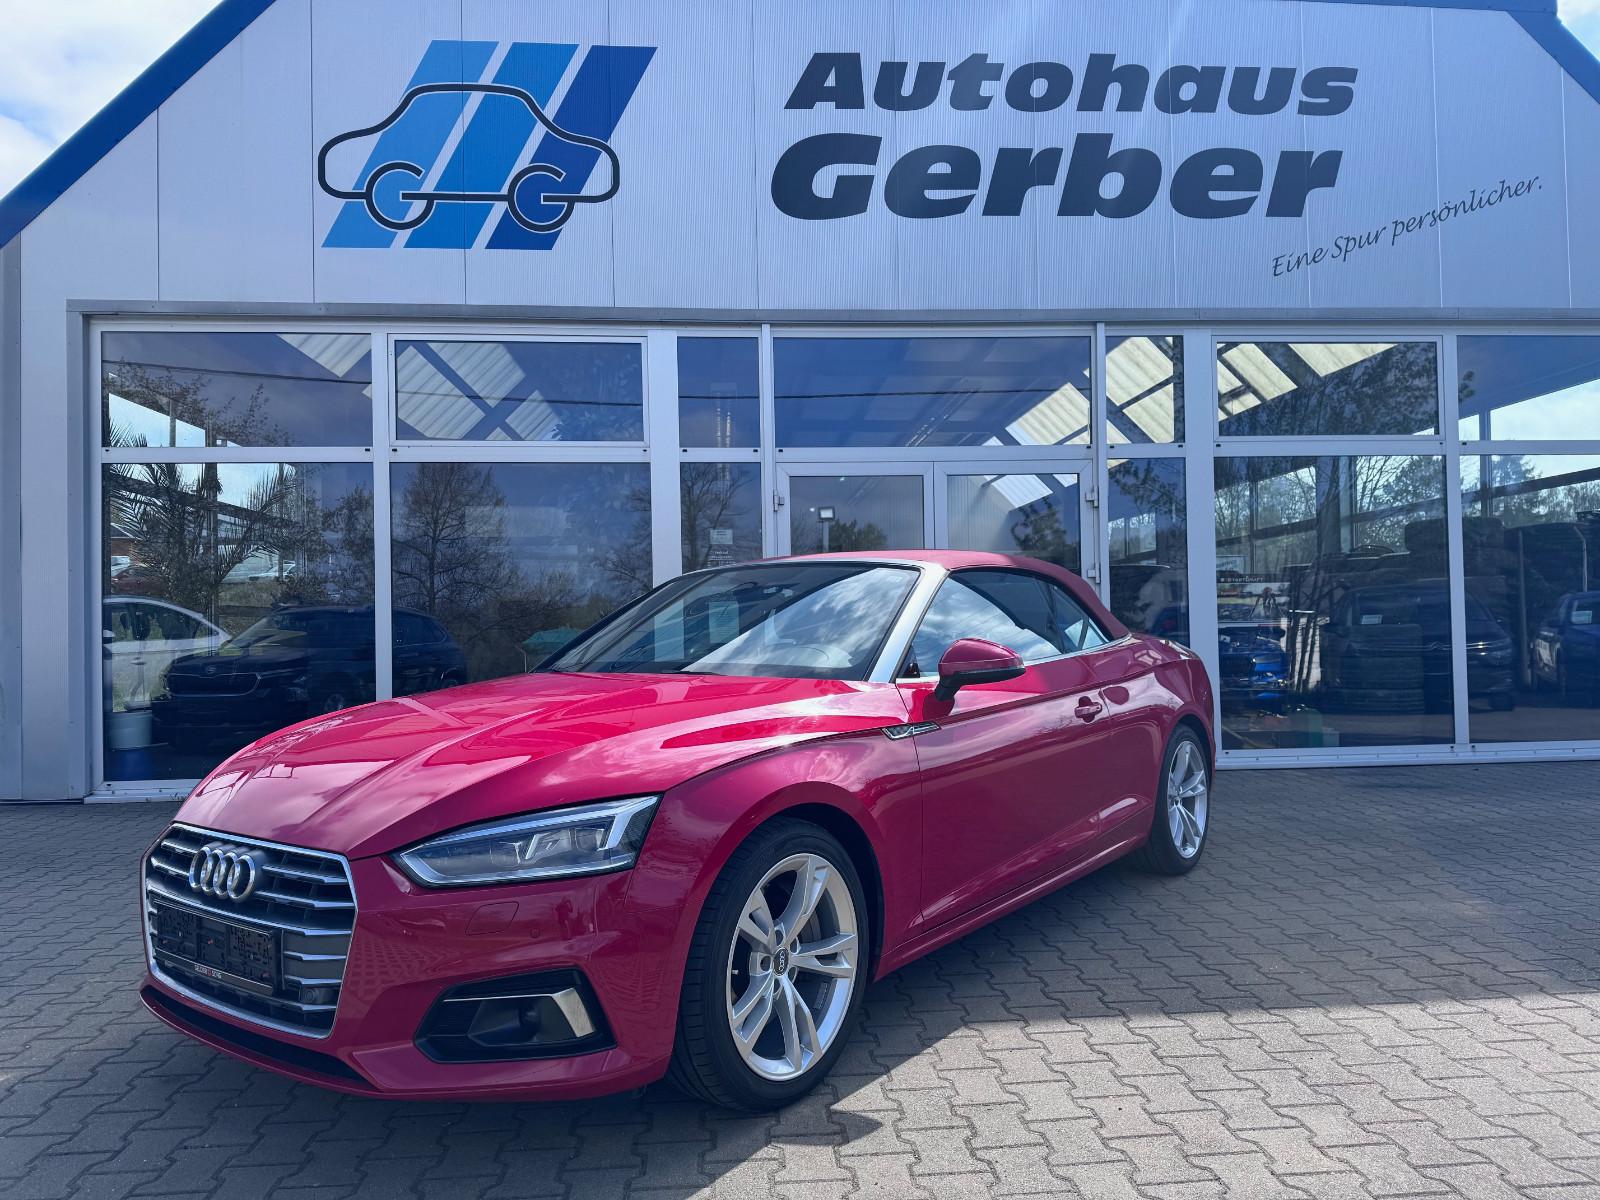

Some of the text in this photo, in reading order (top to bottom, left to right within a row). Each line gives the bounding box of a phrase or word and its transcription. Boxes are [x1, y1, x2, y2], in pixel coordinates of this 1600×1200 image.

[784, 53, 1358, 117] Autohaus
[771, 132, 1344, 221] Gerber
[1272, 175, 1543, 277] Eine Spur persönlicher.
